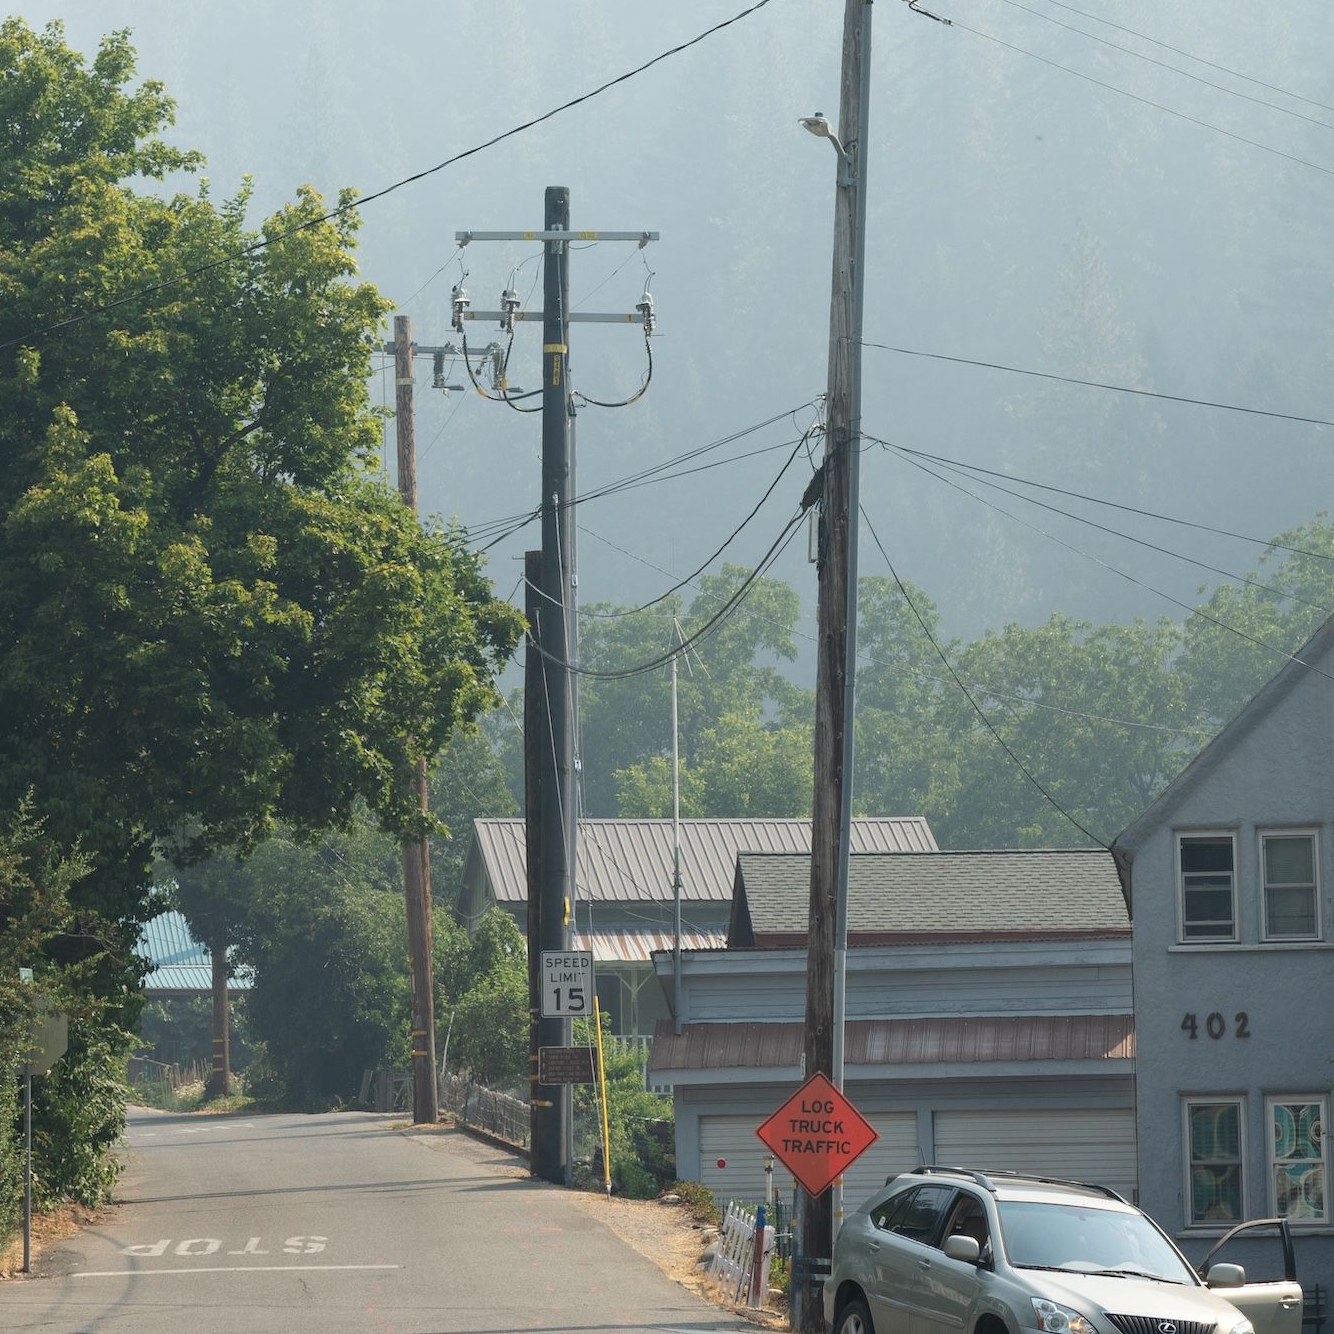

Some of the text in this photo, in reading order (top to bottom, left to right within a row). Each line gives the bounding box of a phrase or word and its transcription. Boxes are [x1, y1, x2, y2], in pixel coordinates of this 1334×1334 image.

[545, 957, 589, 968] SPEED
[550, 972, 586, 983] LIMIT
[553, 987, 585, 1011] 15
[1181, 1011, 1251, 1040] 402
[801, 1100, 835, 1114] LOG
[789, 1119, 844, 1134] TRUCK
[782, 1139, 851, 1155] TRAFFIC
[117, 1234, 330, 1257] STOP
